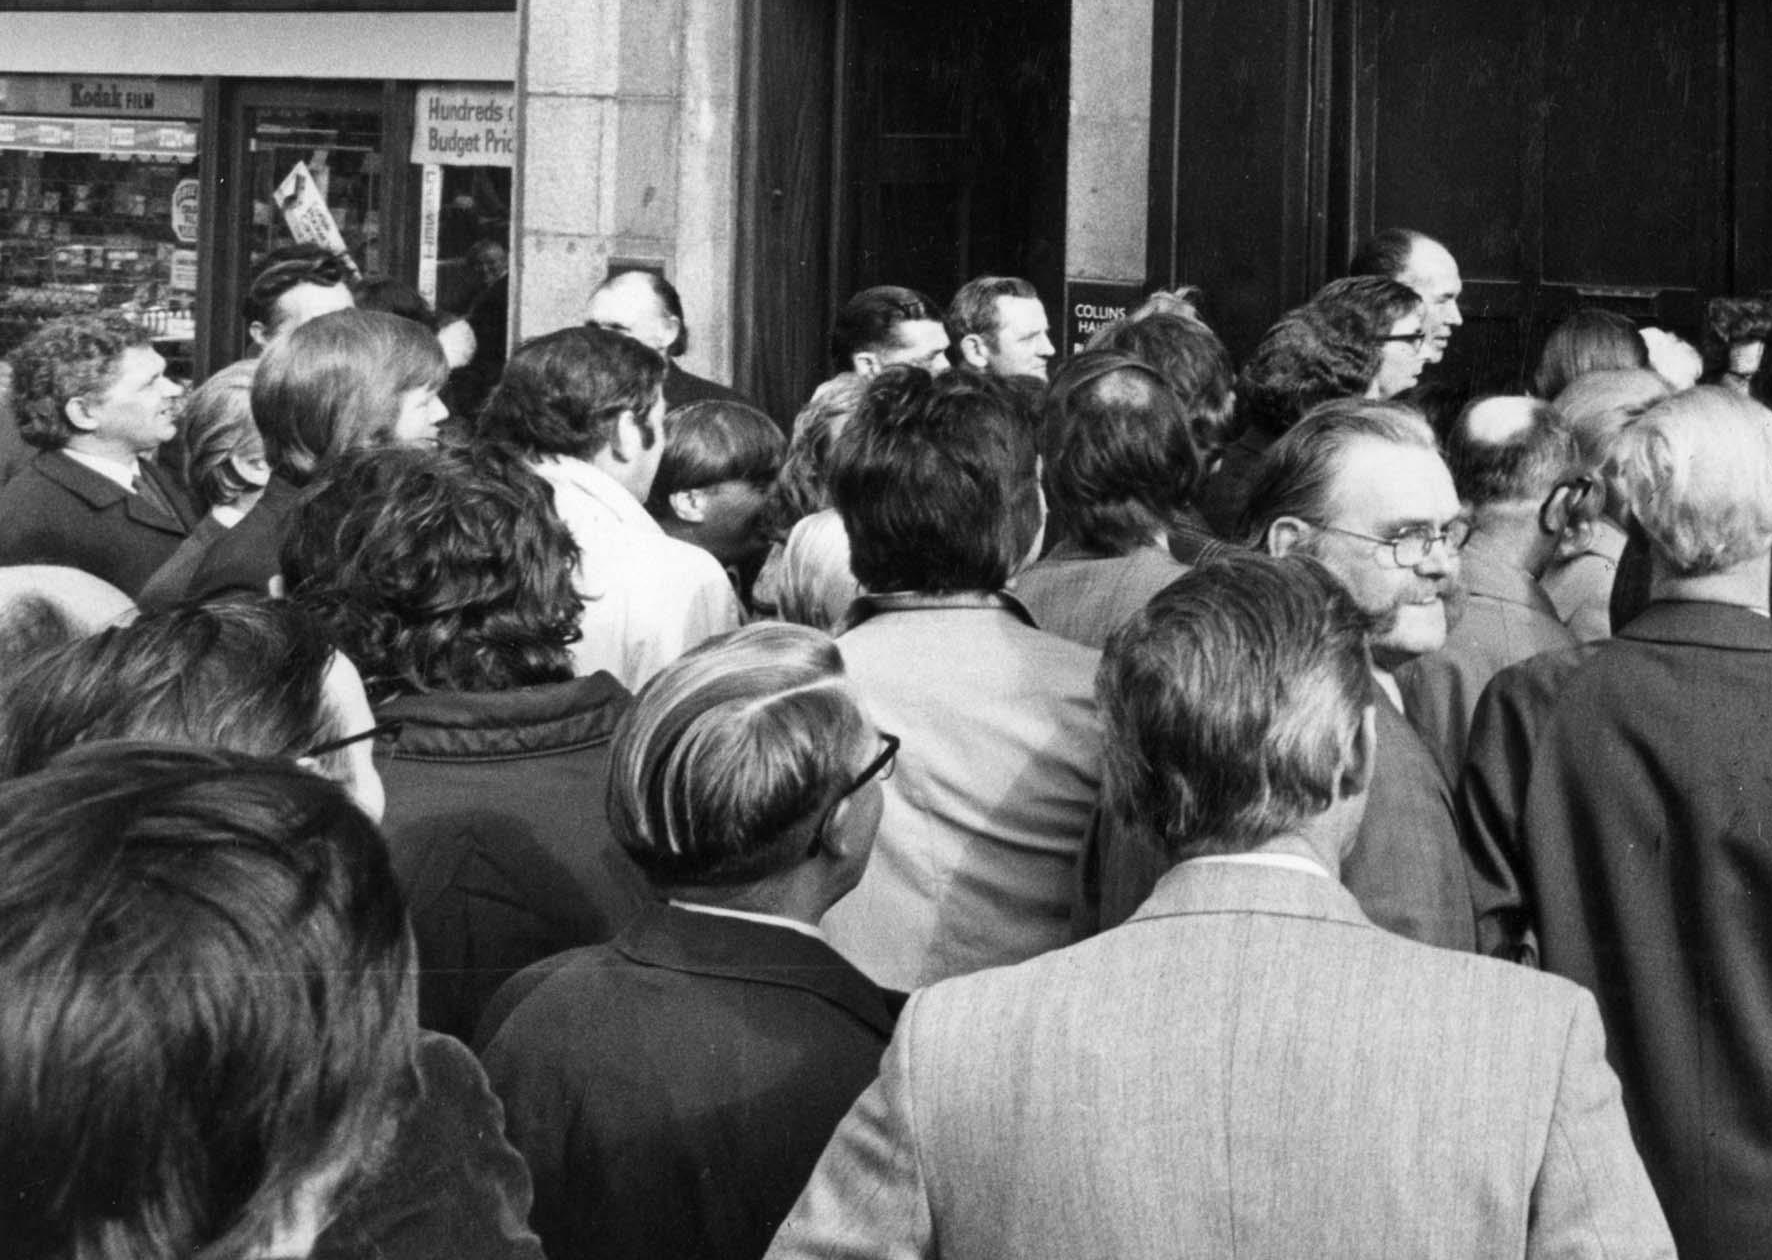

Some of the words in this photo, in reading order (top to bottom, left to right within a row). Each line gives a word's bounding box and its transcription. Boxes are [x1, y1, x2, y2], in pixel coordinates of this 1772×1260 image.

[70, 83, 122, 108] Kodak
[126, 91, 156, 110] FILM
[428, 97, 503, 122] Hundreds
[428, 127, 480, 158] Budget
[1074, 303, 1127, 321] COLLINS
